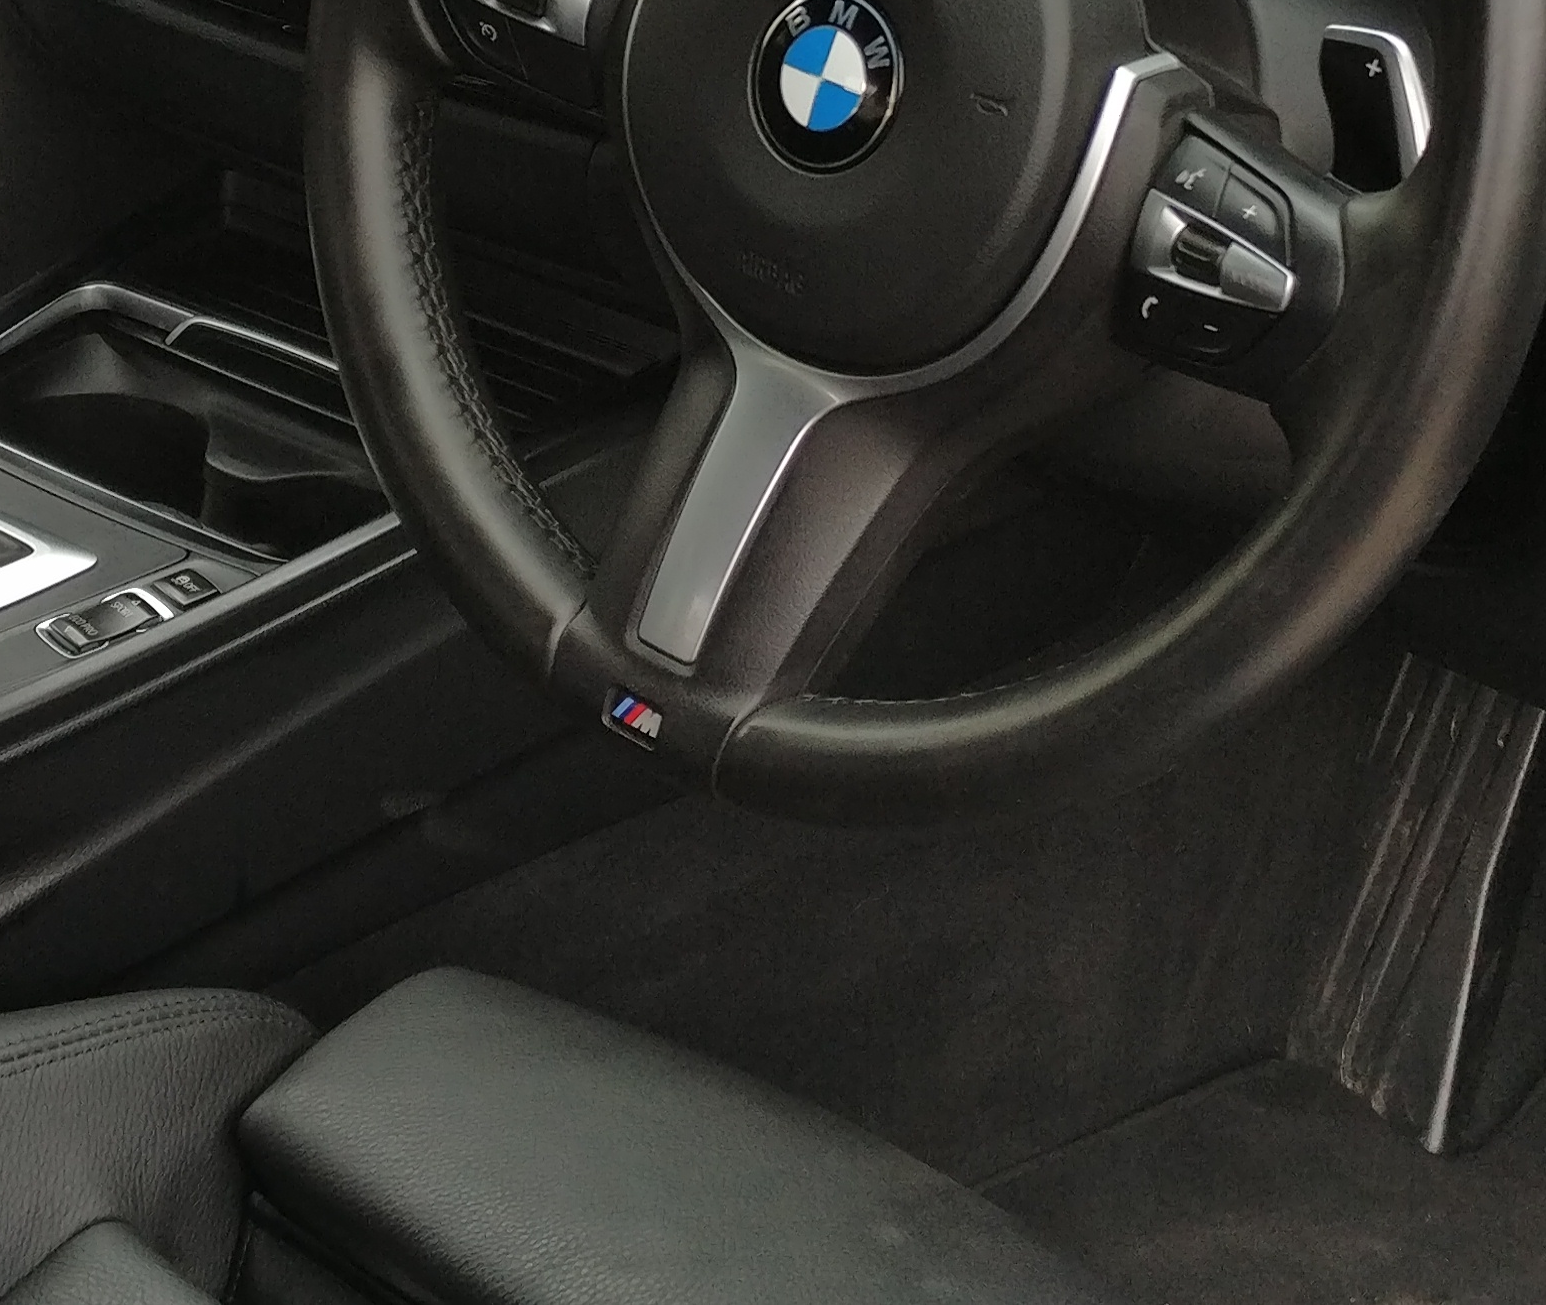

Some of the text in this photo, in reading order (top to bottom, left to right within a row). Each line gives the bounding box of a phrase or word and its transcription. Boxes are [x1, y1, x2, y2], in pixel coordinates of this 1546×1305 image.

[784, 0, 891, 70] BMW
[109, 601, 133, 618] SPORT
[82, 621, 99, 636] PRO
